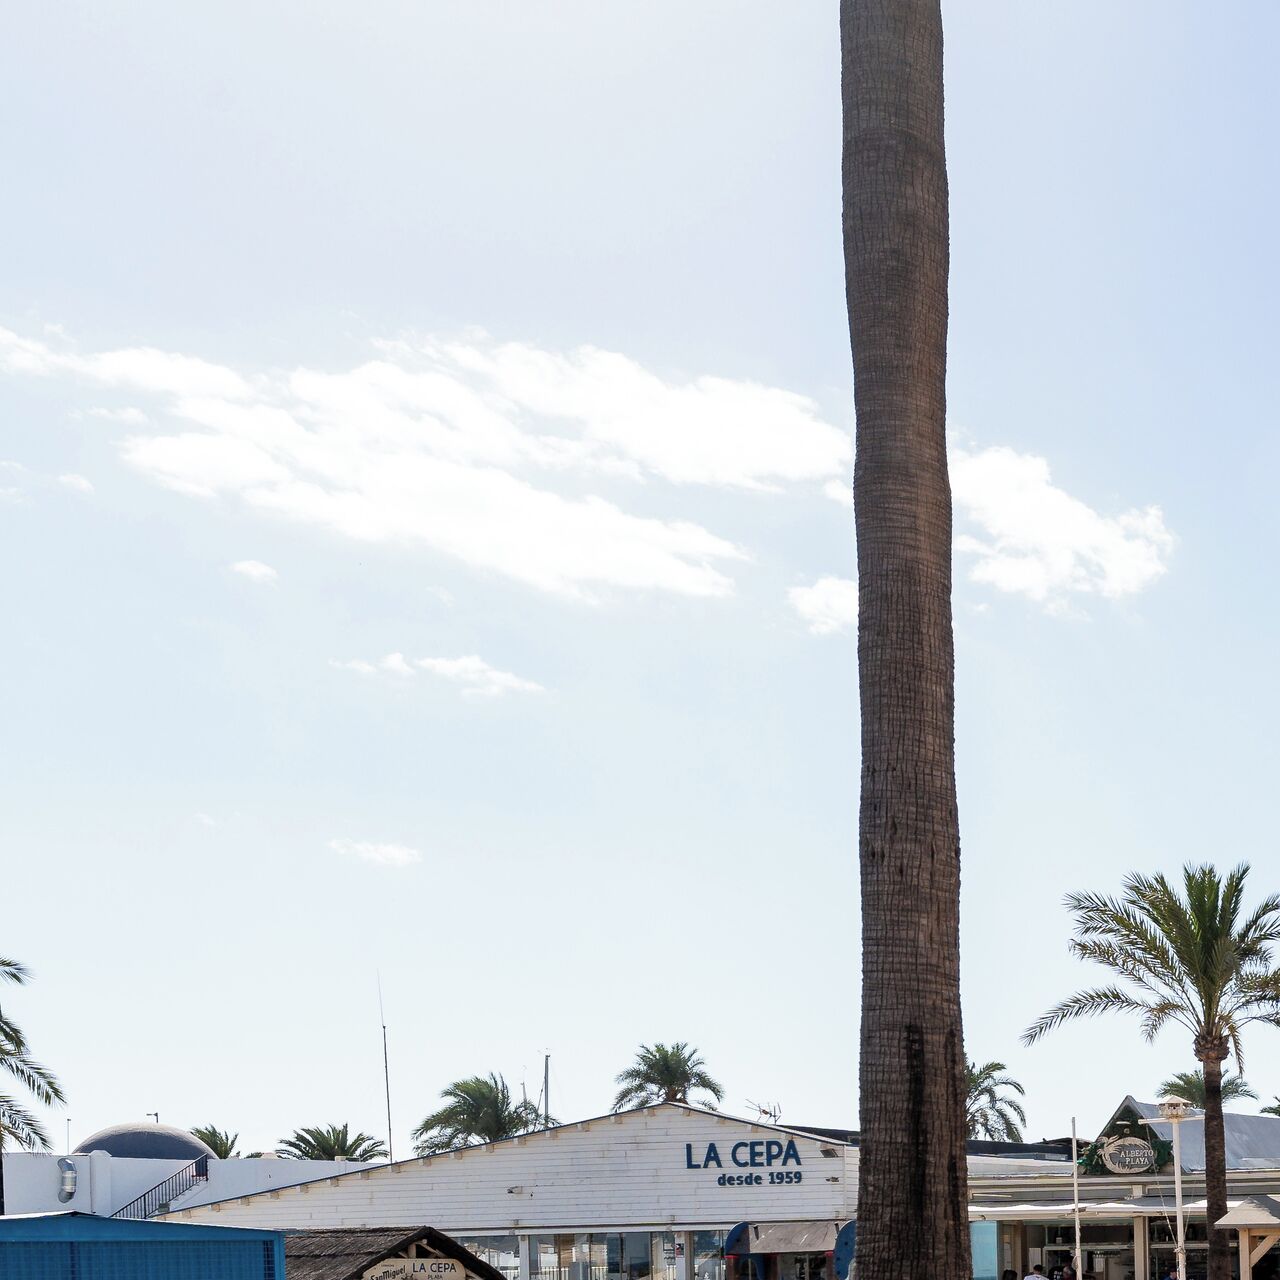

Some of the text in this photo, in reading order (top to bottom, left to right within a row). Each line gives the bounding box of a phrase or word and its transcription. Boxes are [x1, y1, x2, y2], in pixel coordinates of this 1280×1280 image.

[685, 1139, 802, 1169] LA CEPA
[1120, 1149, 1154, 1158] ALBERTO
[1126, 1157, 1150, 1165] PLAYA
[717, 1171, 803, 1187] desde 1959
[412, 1262, 457, 1273] LA CEPA
